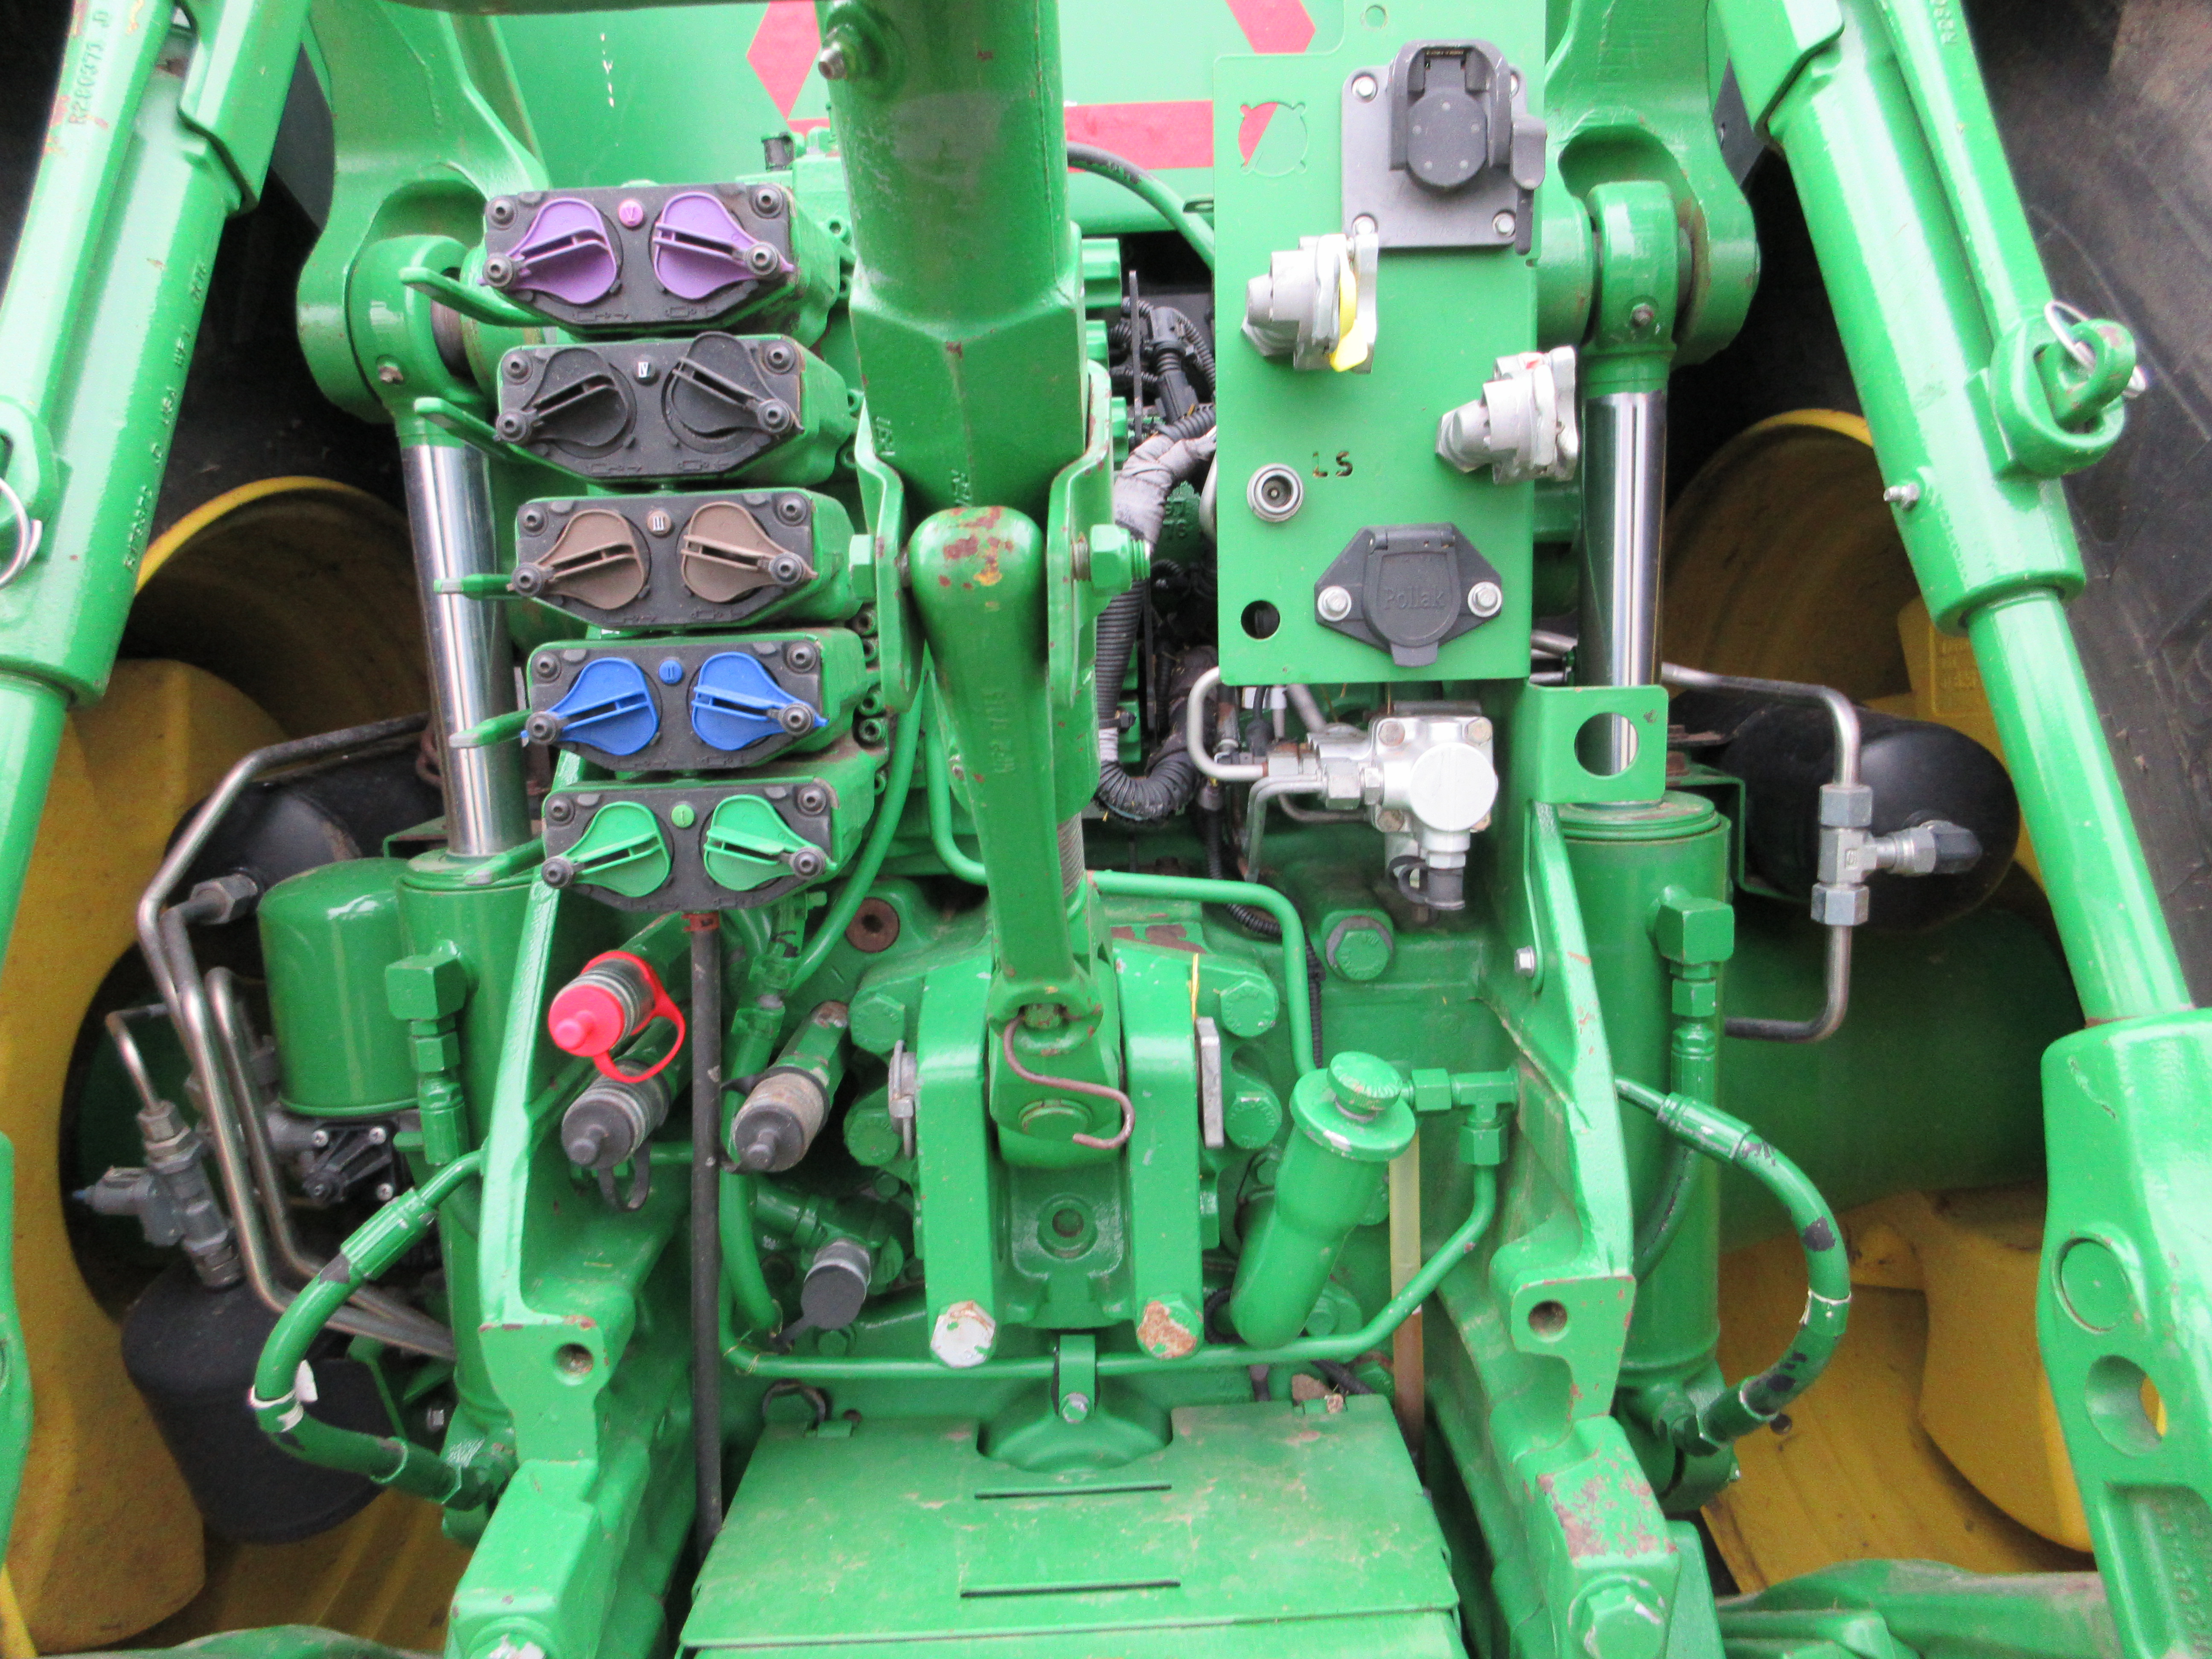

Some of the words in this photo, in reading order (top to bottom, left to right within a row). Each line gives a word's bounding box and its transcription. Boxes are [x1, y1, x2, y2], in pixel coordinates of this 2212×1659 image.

[637, 361, 649, 378] IV
[1313, 451, 1353, 477] LS
[652, 515, 664, 531] III
[1383, 585, 1446, 611] Pollak
